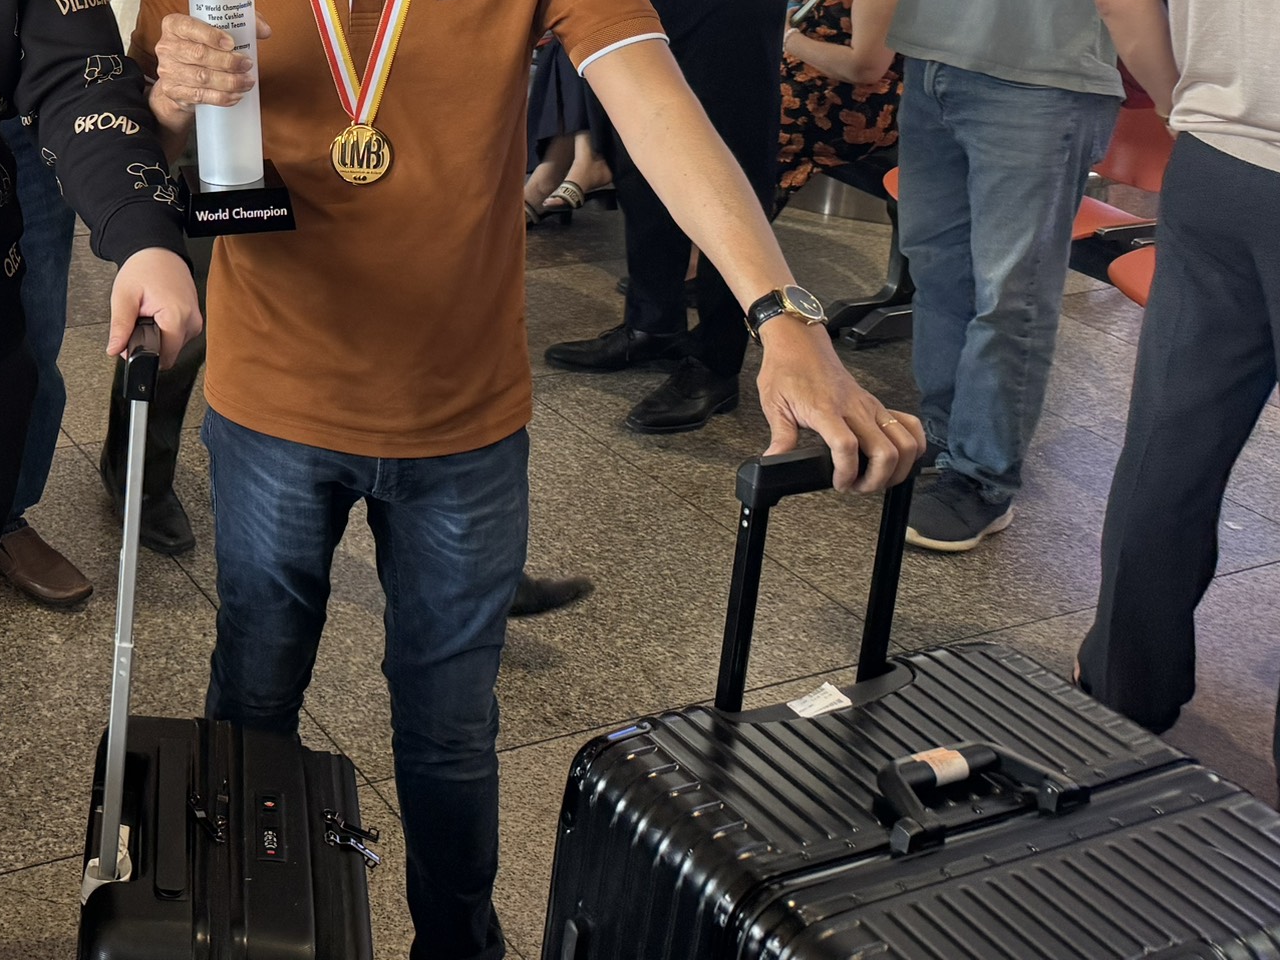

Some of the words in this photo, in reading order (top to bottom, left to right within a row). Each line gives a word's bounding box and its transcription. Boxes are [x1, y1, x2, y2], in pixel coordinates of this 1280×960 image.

[205, 4, 221, 12] World
[231, 21, 246, 29] Teams
[74, 112, 140, 135] BROAD
[196, 208, 229, 221] World
[232, 206, 288, 220] Champion
